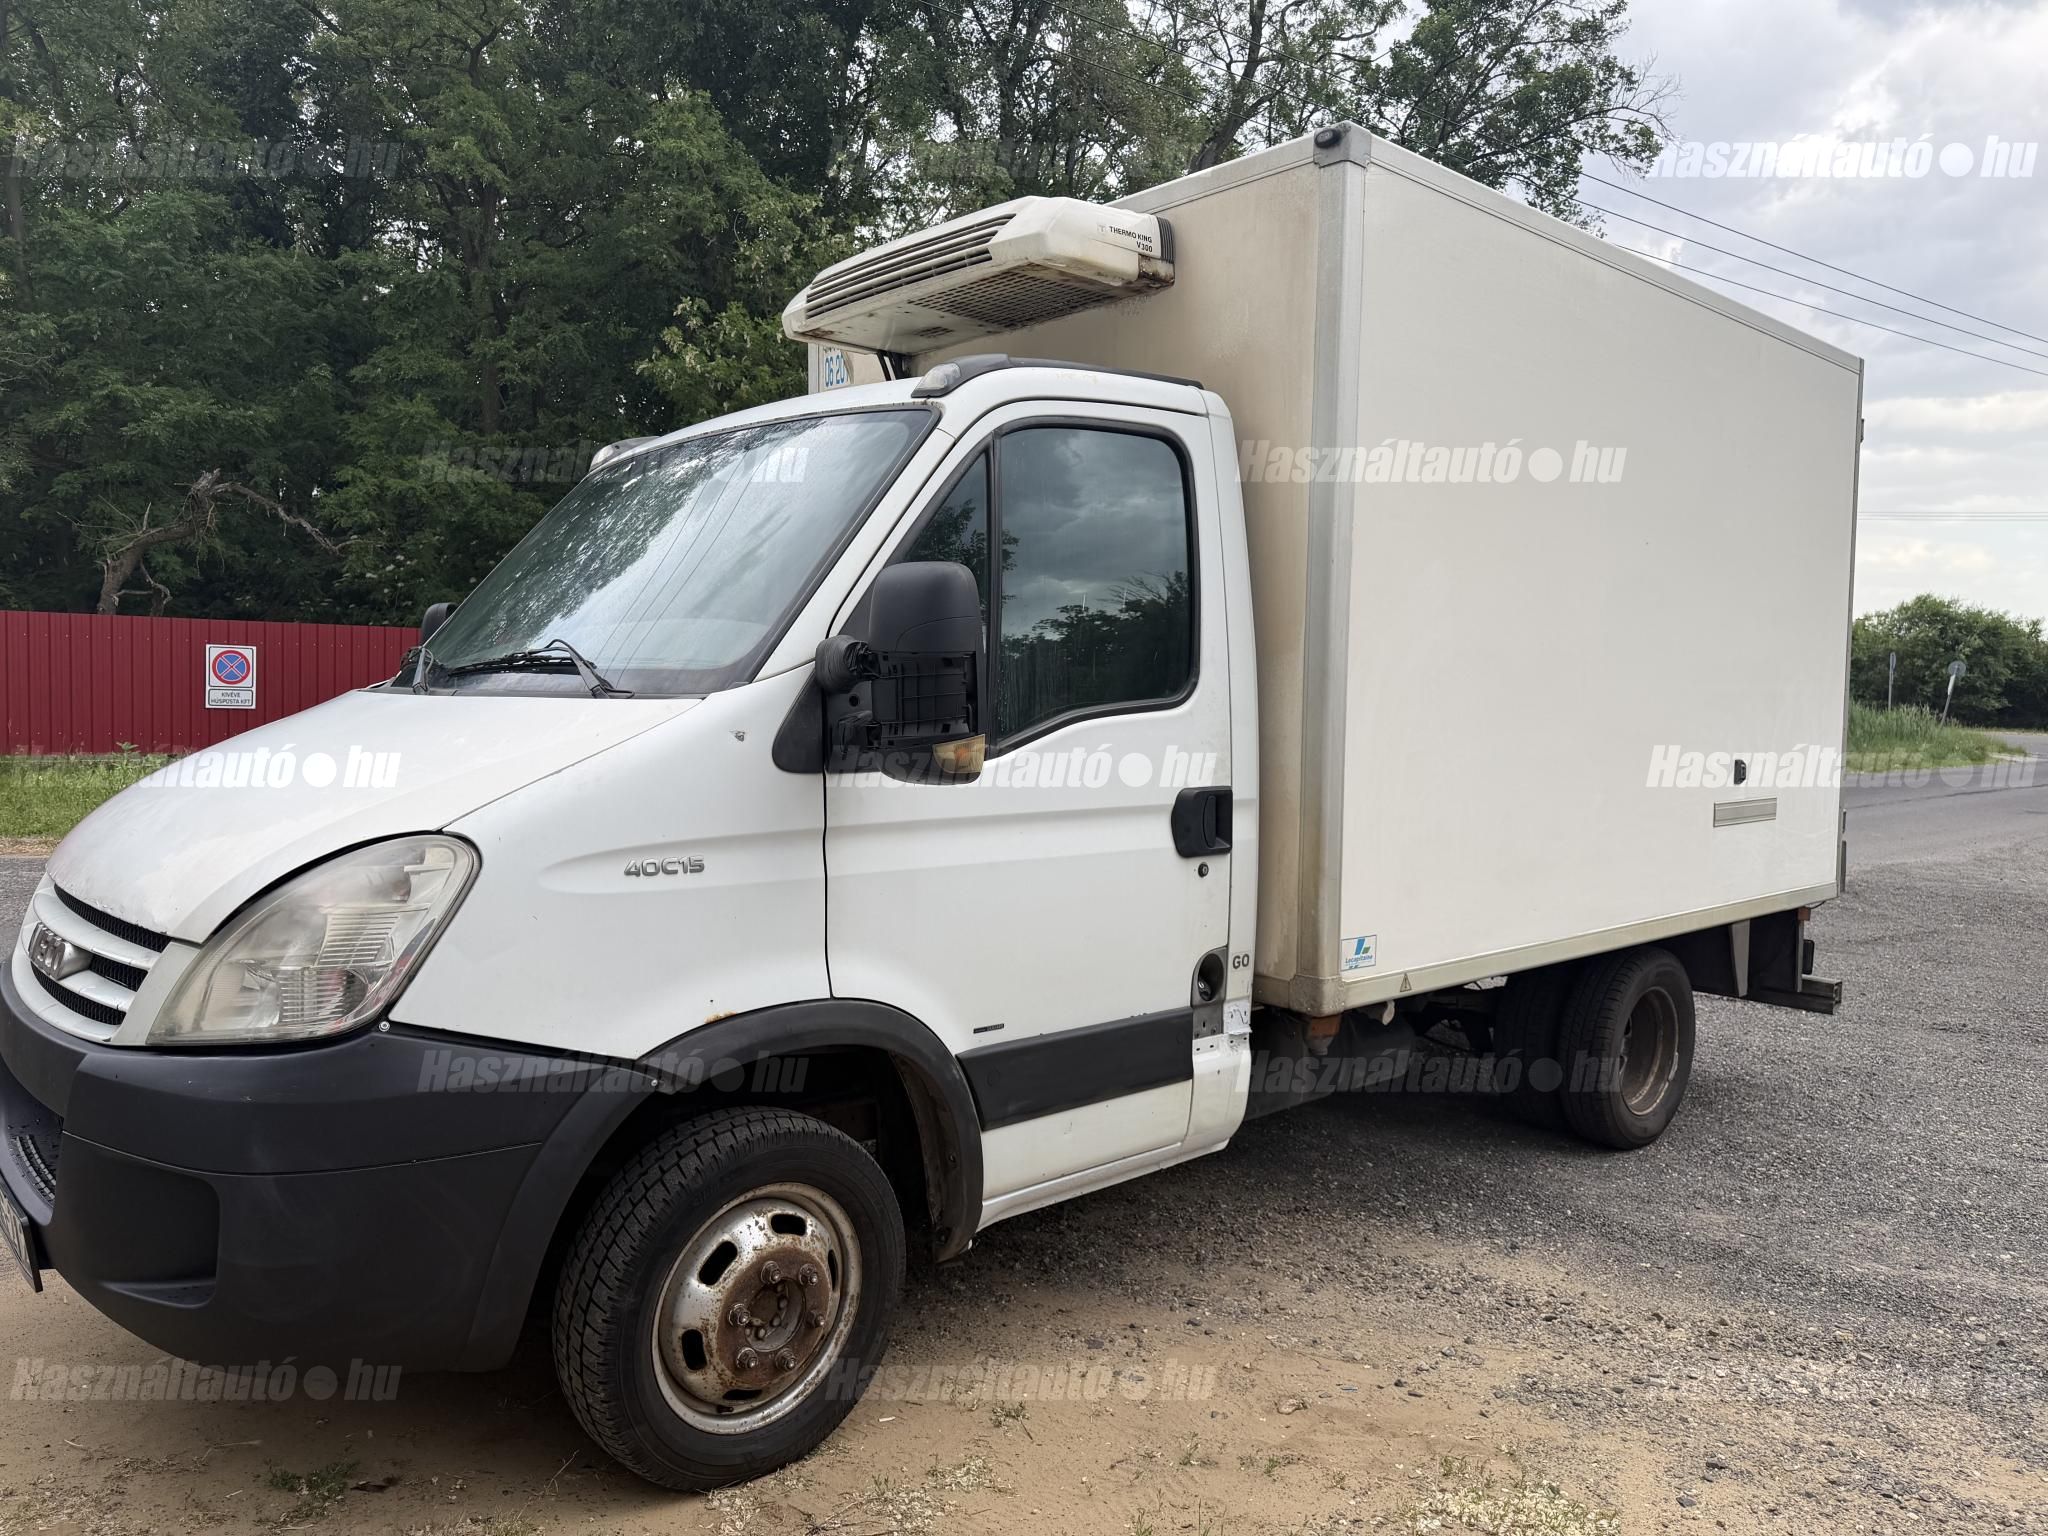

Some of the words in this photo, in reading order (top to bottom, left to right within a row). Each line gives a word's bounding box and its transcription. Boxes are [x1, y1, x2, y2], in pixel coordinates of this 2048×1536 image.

[1108, 226, 1137, 239] THERMO
[1137, 233, 1152, 243] KING
[623, 856, 705, 877] 40C15
